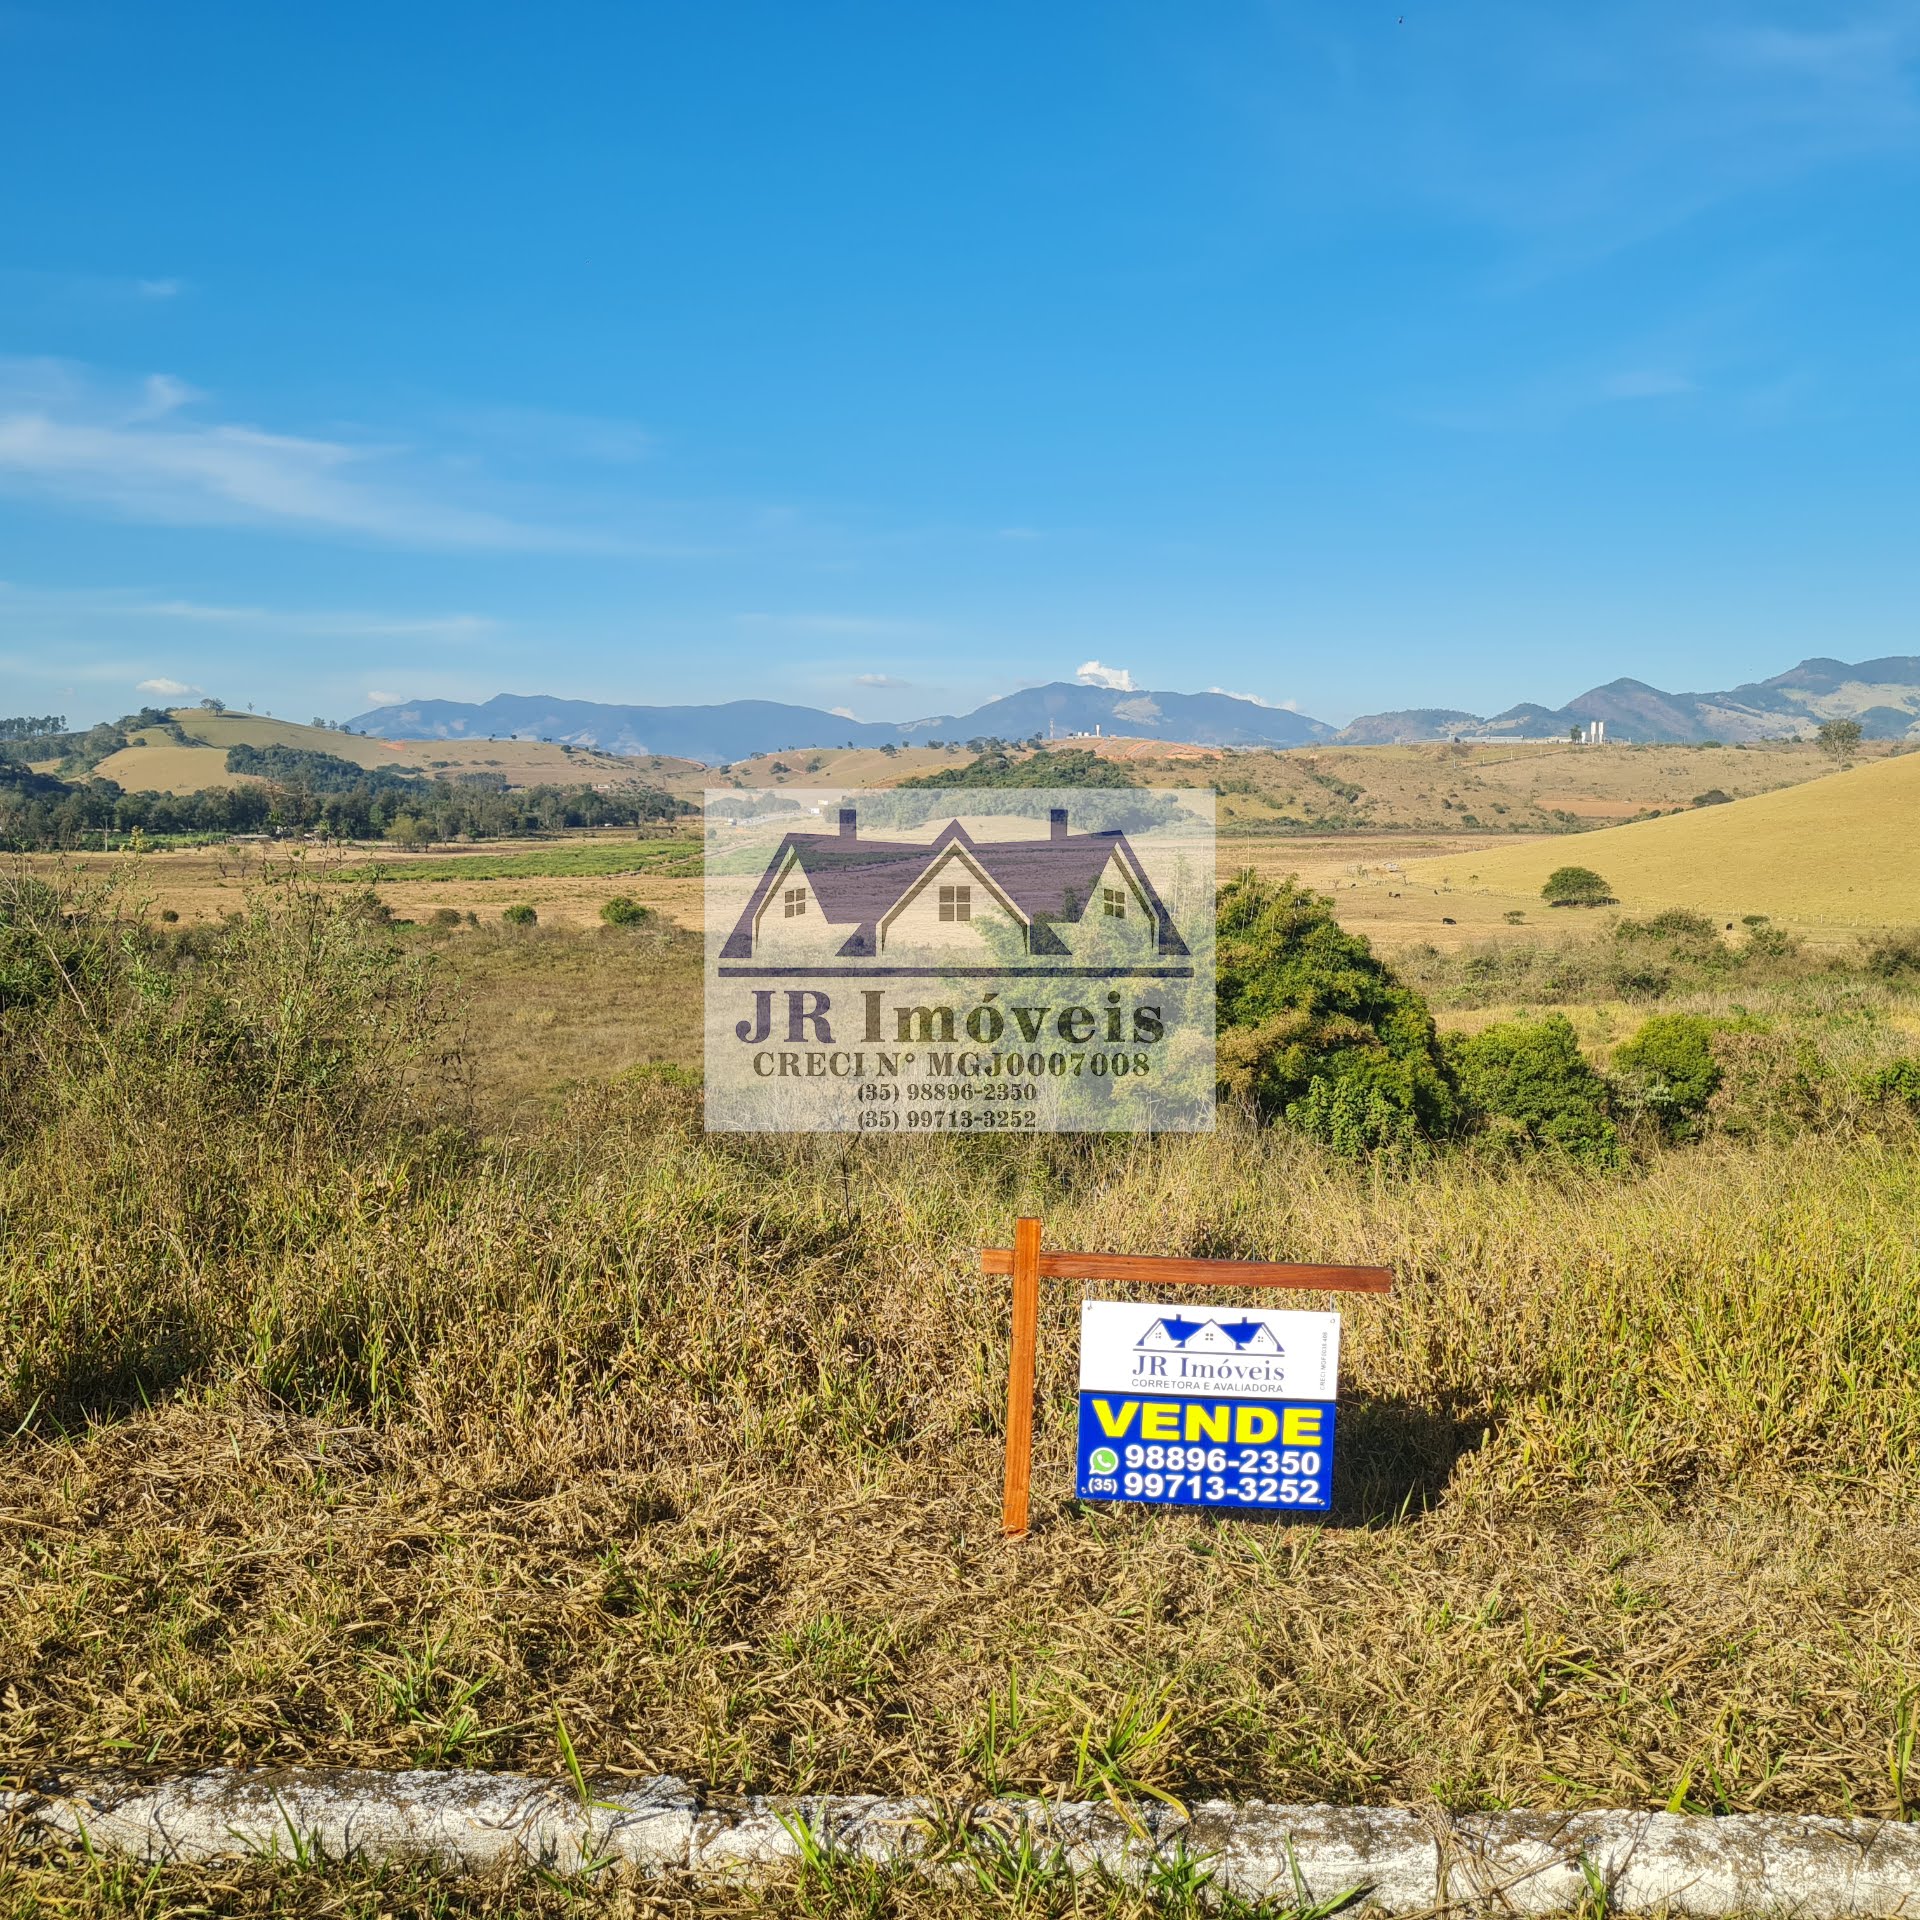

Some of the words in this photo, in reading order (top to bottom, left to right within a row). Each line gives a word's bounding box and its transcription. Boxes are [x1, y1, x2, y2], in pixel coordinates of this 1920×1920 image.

[1132, 1355, 1169, 1377] JR
[1179, 1357, 1285, 1381] Imóveis
[1131, 1378, 1200, 1390] CORRETORA
[1203, 1381, 1211, 1390] E
[1213, 1382, 1284, 1393] AVALIADORA
[1092, 1399, 1323, 1447] VENDE
[1125, 1444, 1321, 1476] 98896-2350
[1088, 1477, 1118, 1495] (35)
[1124, 1473, 1320, 1504] 99713-3252
